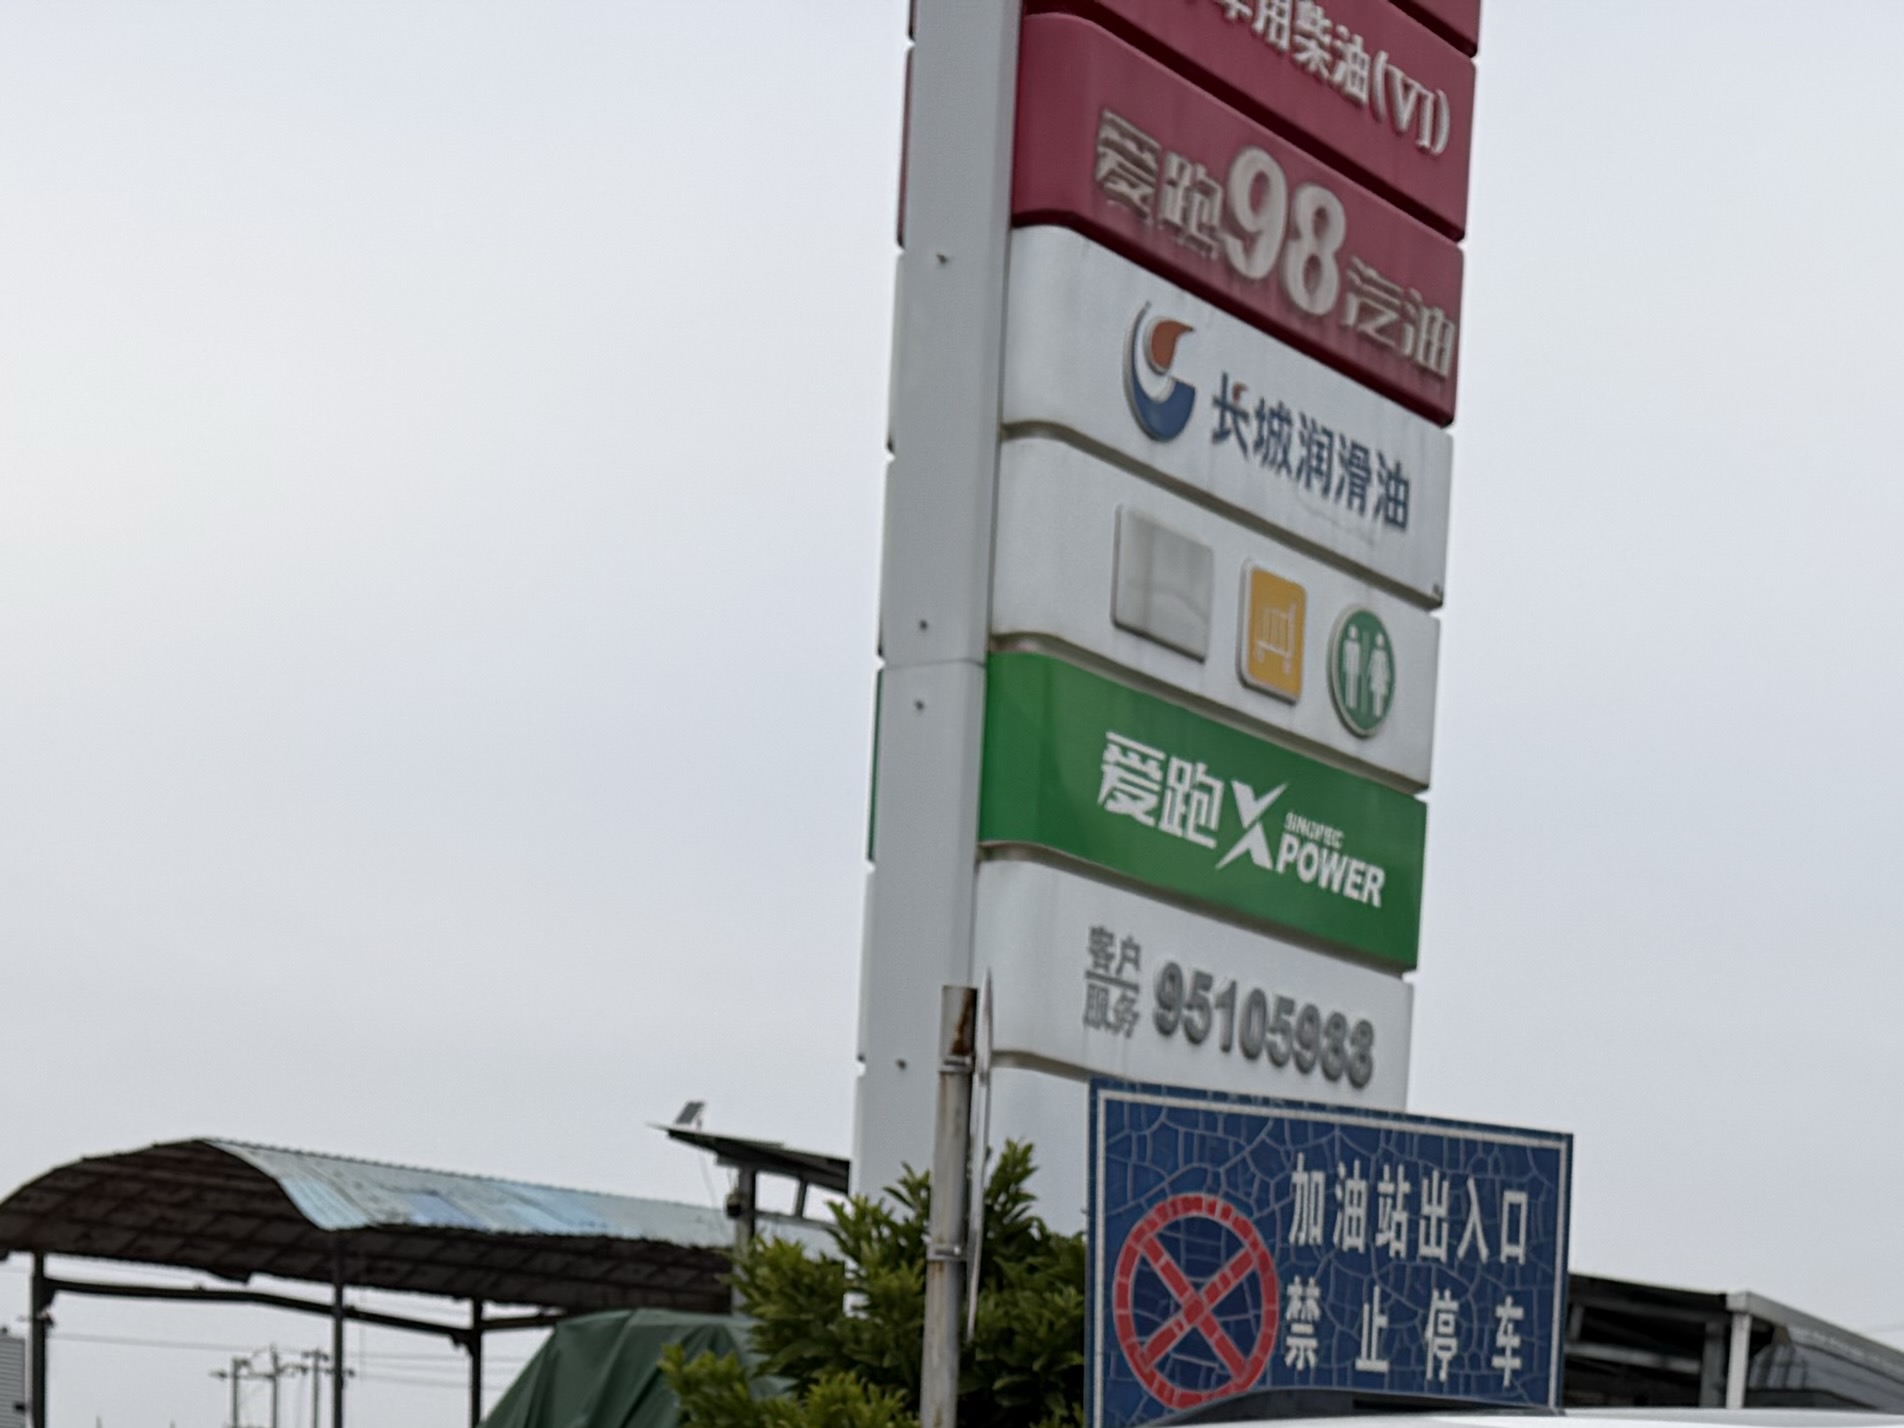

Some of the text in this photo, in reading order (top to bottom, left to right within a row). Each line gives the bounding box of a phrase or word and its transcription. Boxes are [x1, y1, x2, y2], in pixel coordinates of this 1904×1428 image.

[1212, 372, 1410, 531] 长城润滑油
[1098, 731, 1224, 850] 爱跑
[1276, 832, 1386, 908] POWER
[1288, 1151, 1529, 1266] 加油站出入口
[1284, 1275, 1525, 1389] 禁止停车
